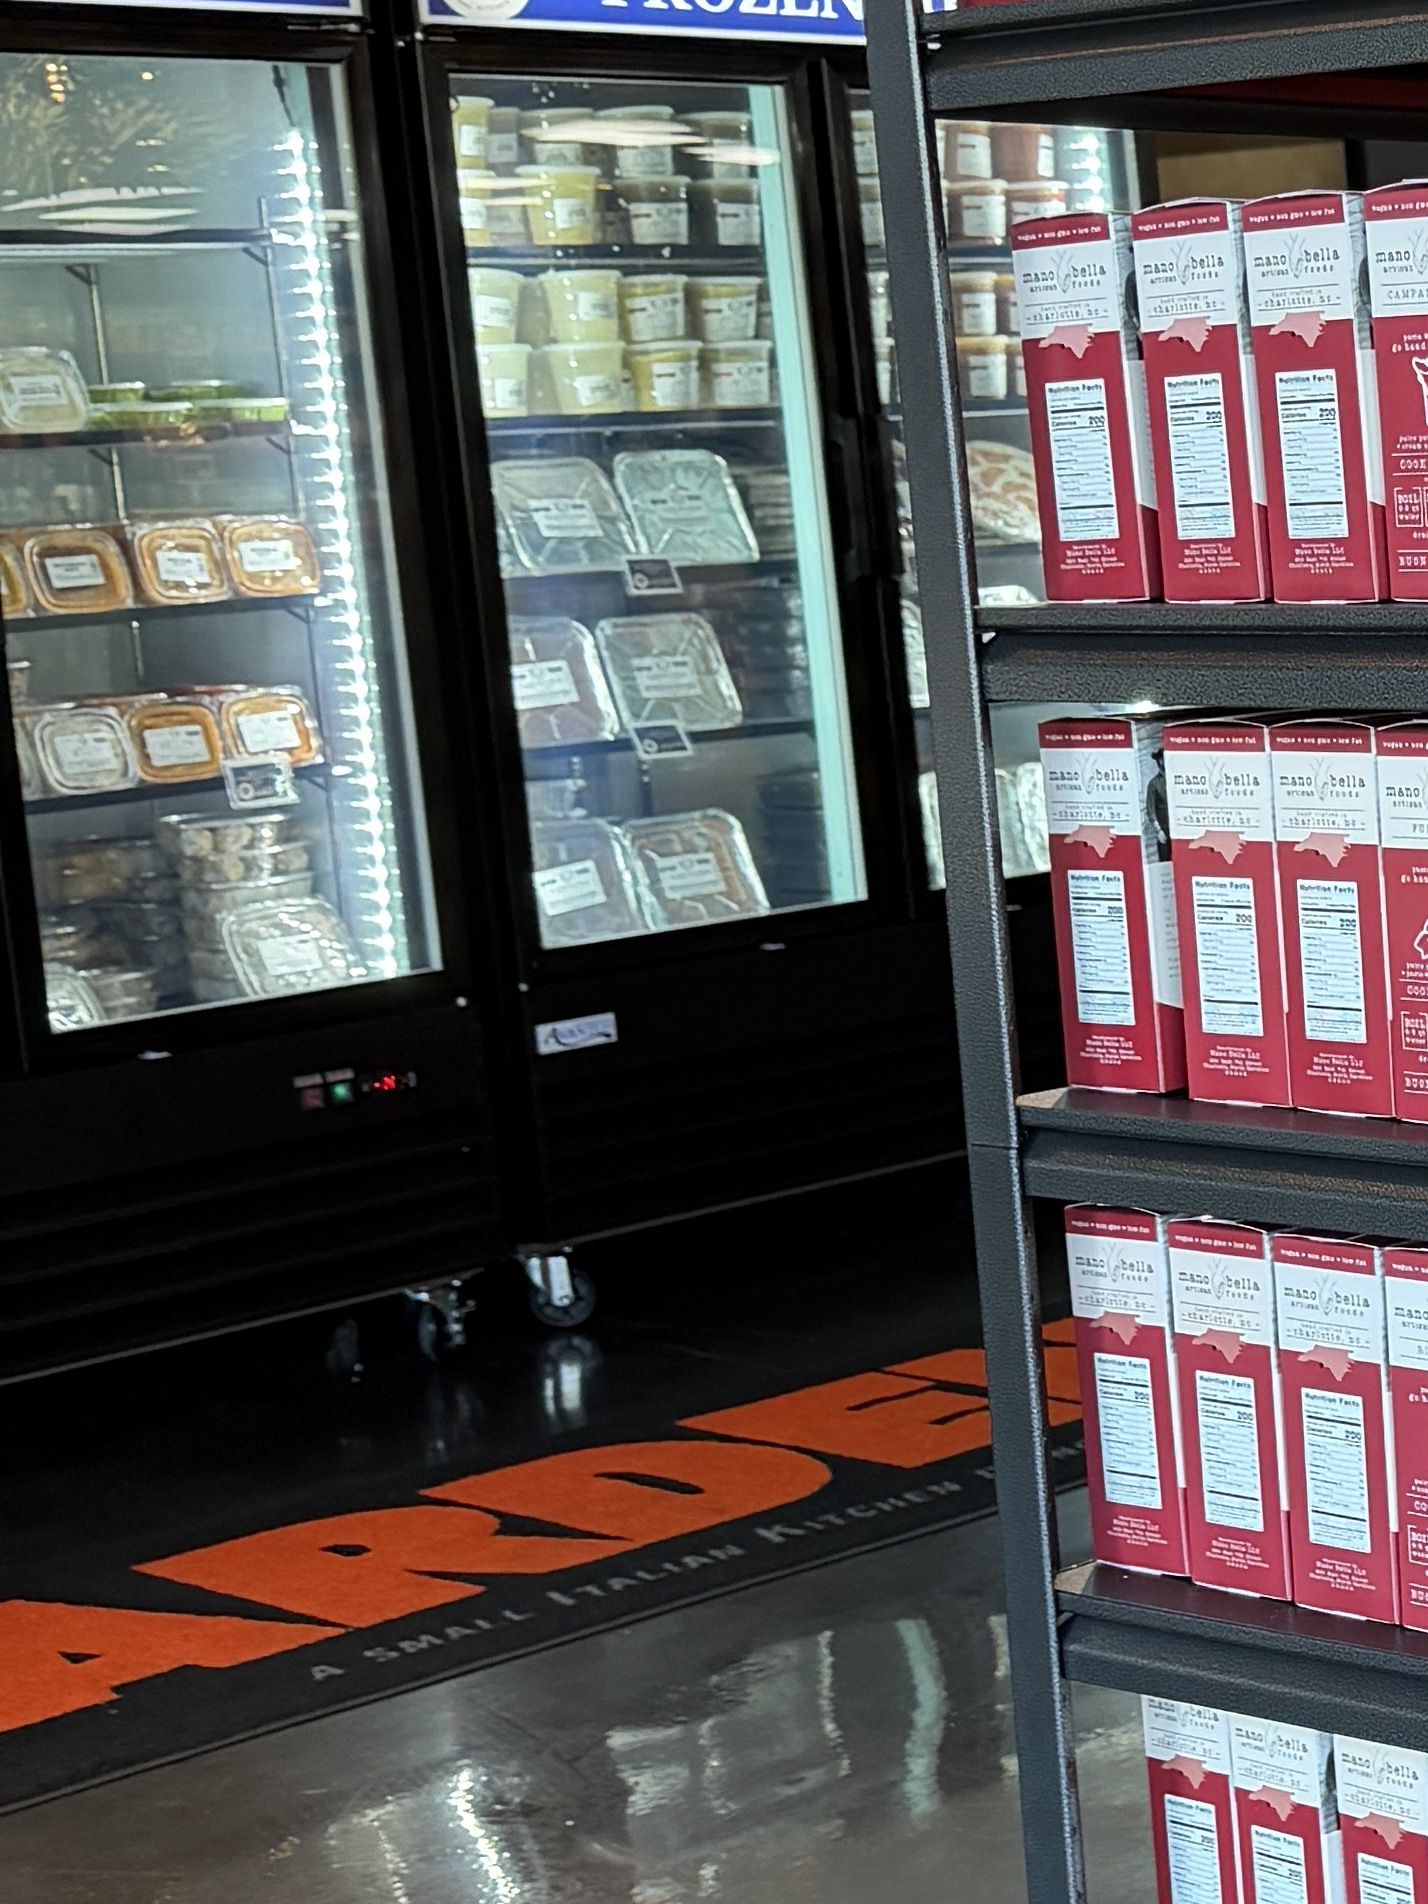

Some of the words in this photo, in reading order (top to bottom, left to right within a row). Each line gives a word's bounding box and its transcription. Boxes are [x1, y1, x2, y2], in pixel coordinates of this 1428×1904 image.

[363, 1607, 534, 1663] SMALL
[548, 1543, 744, 1608] ITALIAN
[755, 1480, 959, 1545] KITCHEN
